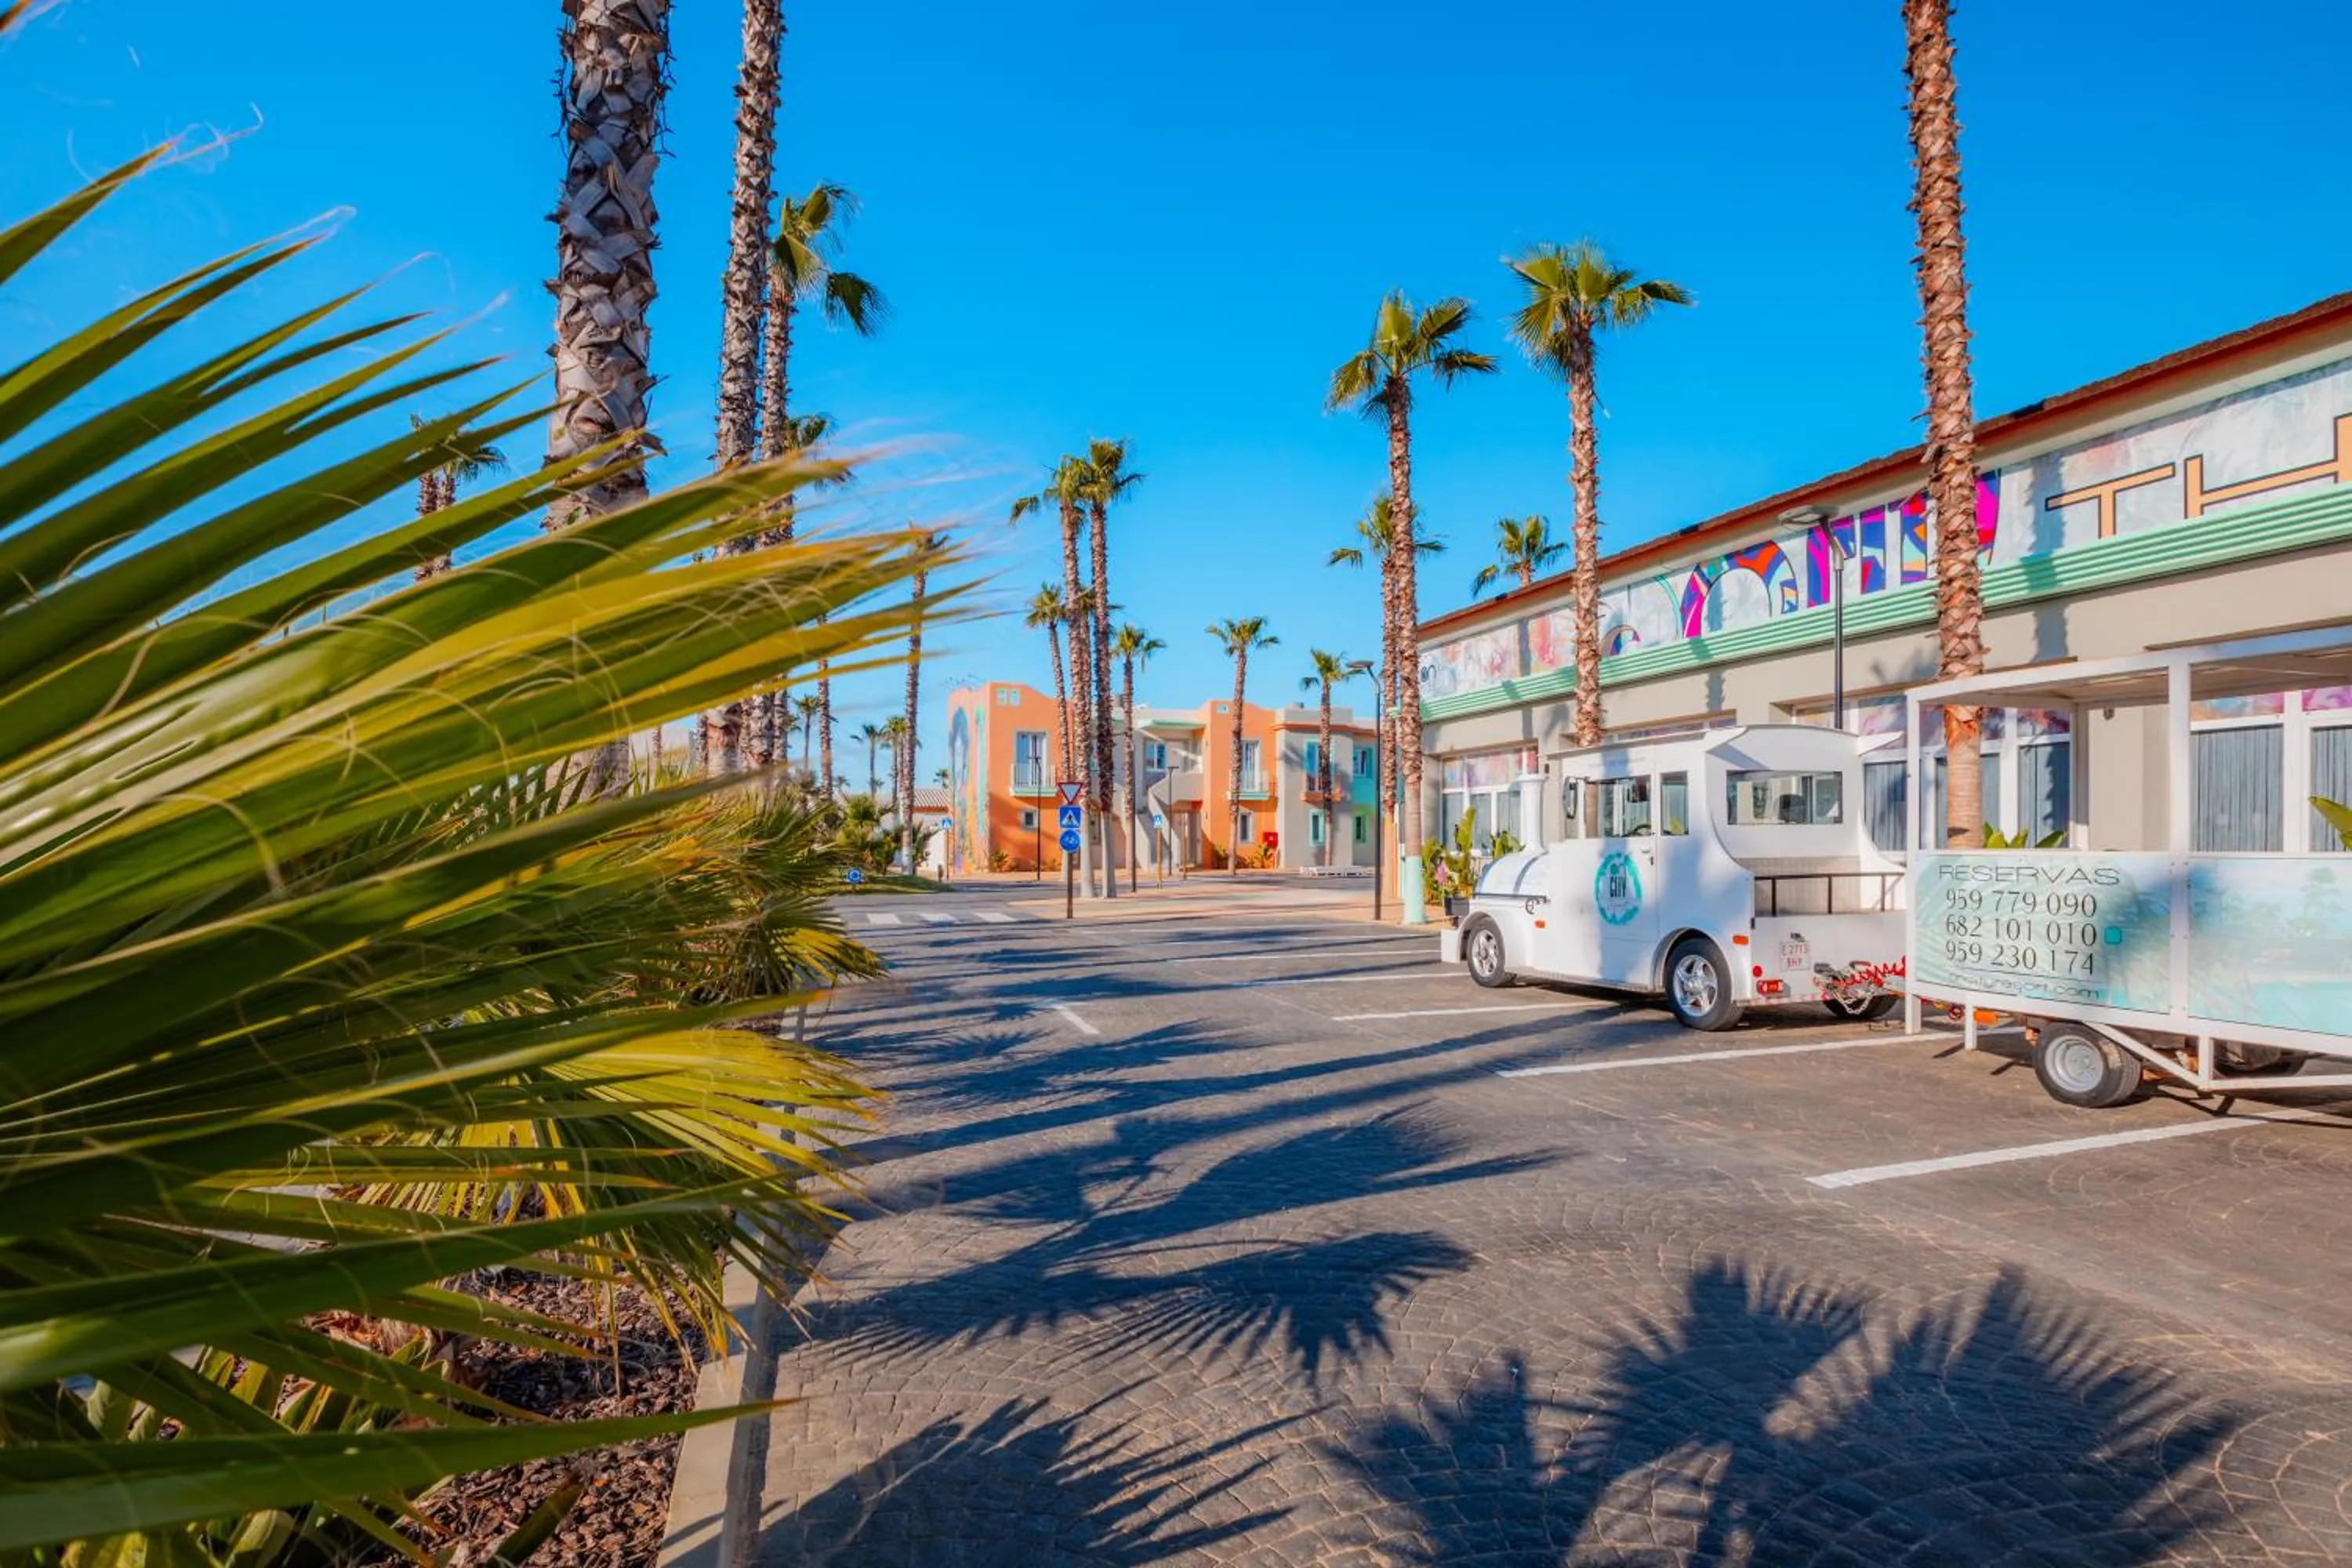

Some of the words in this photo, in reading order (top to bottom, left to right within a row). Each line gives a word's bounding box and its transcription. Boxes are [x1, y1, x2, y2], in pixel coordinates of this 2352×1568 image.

[1939, 865, 2120, 885] RESERVAS
[1946, 888, 1983, 910] 959
[1992, 891, 2038, 914] 779
[2046, 892, 2097, 917] 090
[1946, 913, 1982, 937] 682
[1994, 918, 2032, 941] 101
[2046, 920, 2097, 947] 010
[1945, 940, 1982, 964] 959
[1991, 945, 2037, 970] 230
[2050, 949, 2095, 975] 174
